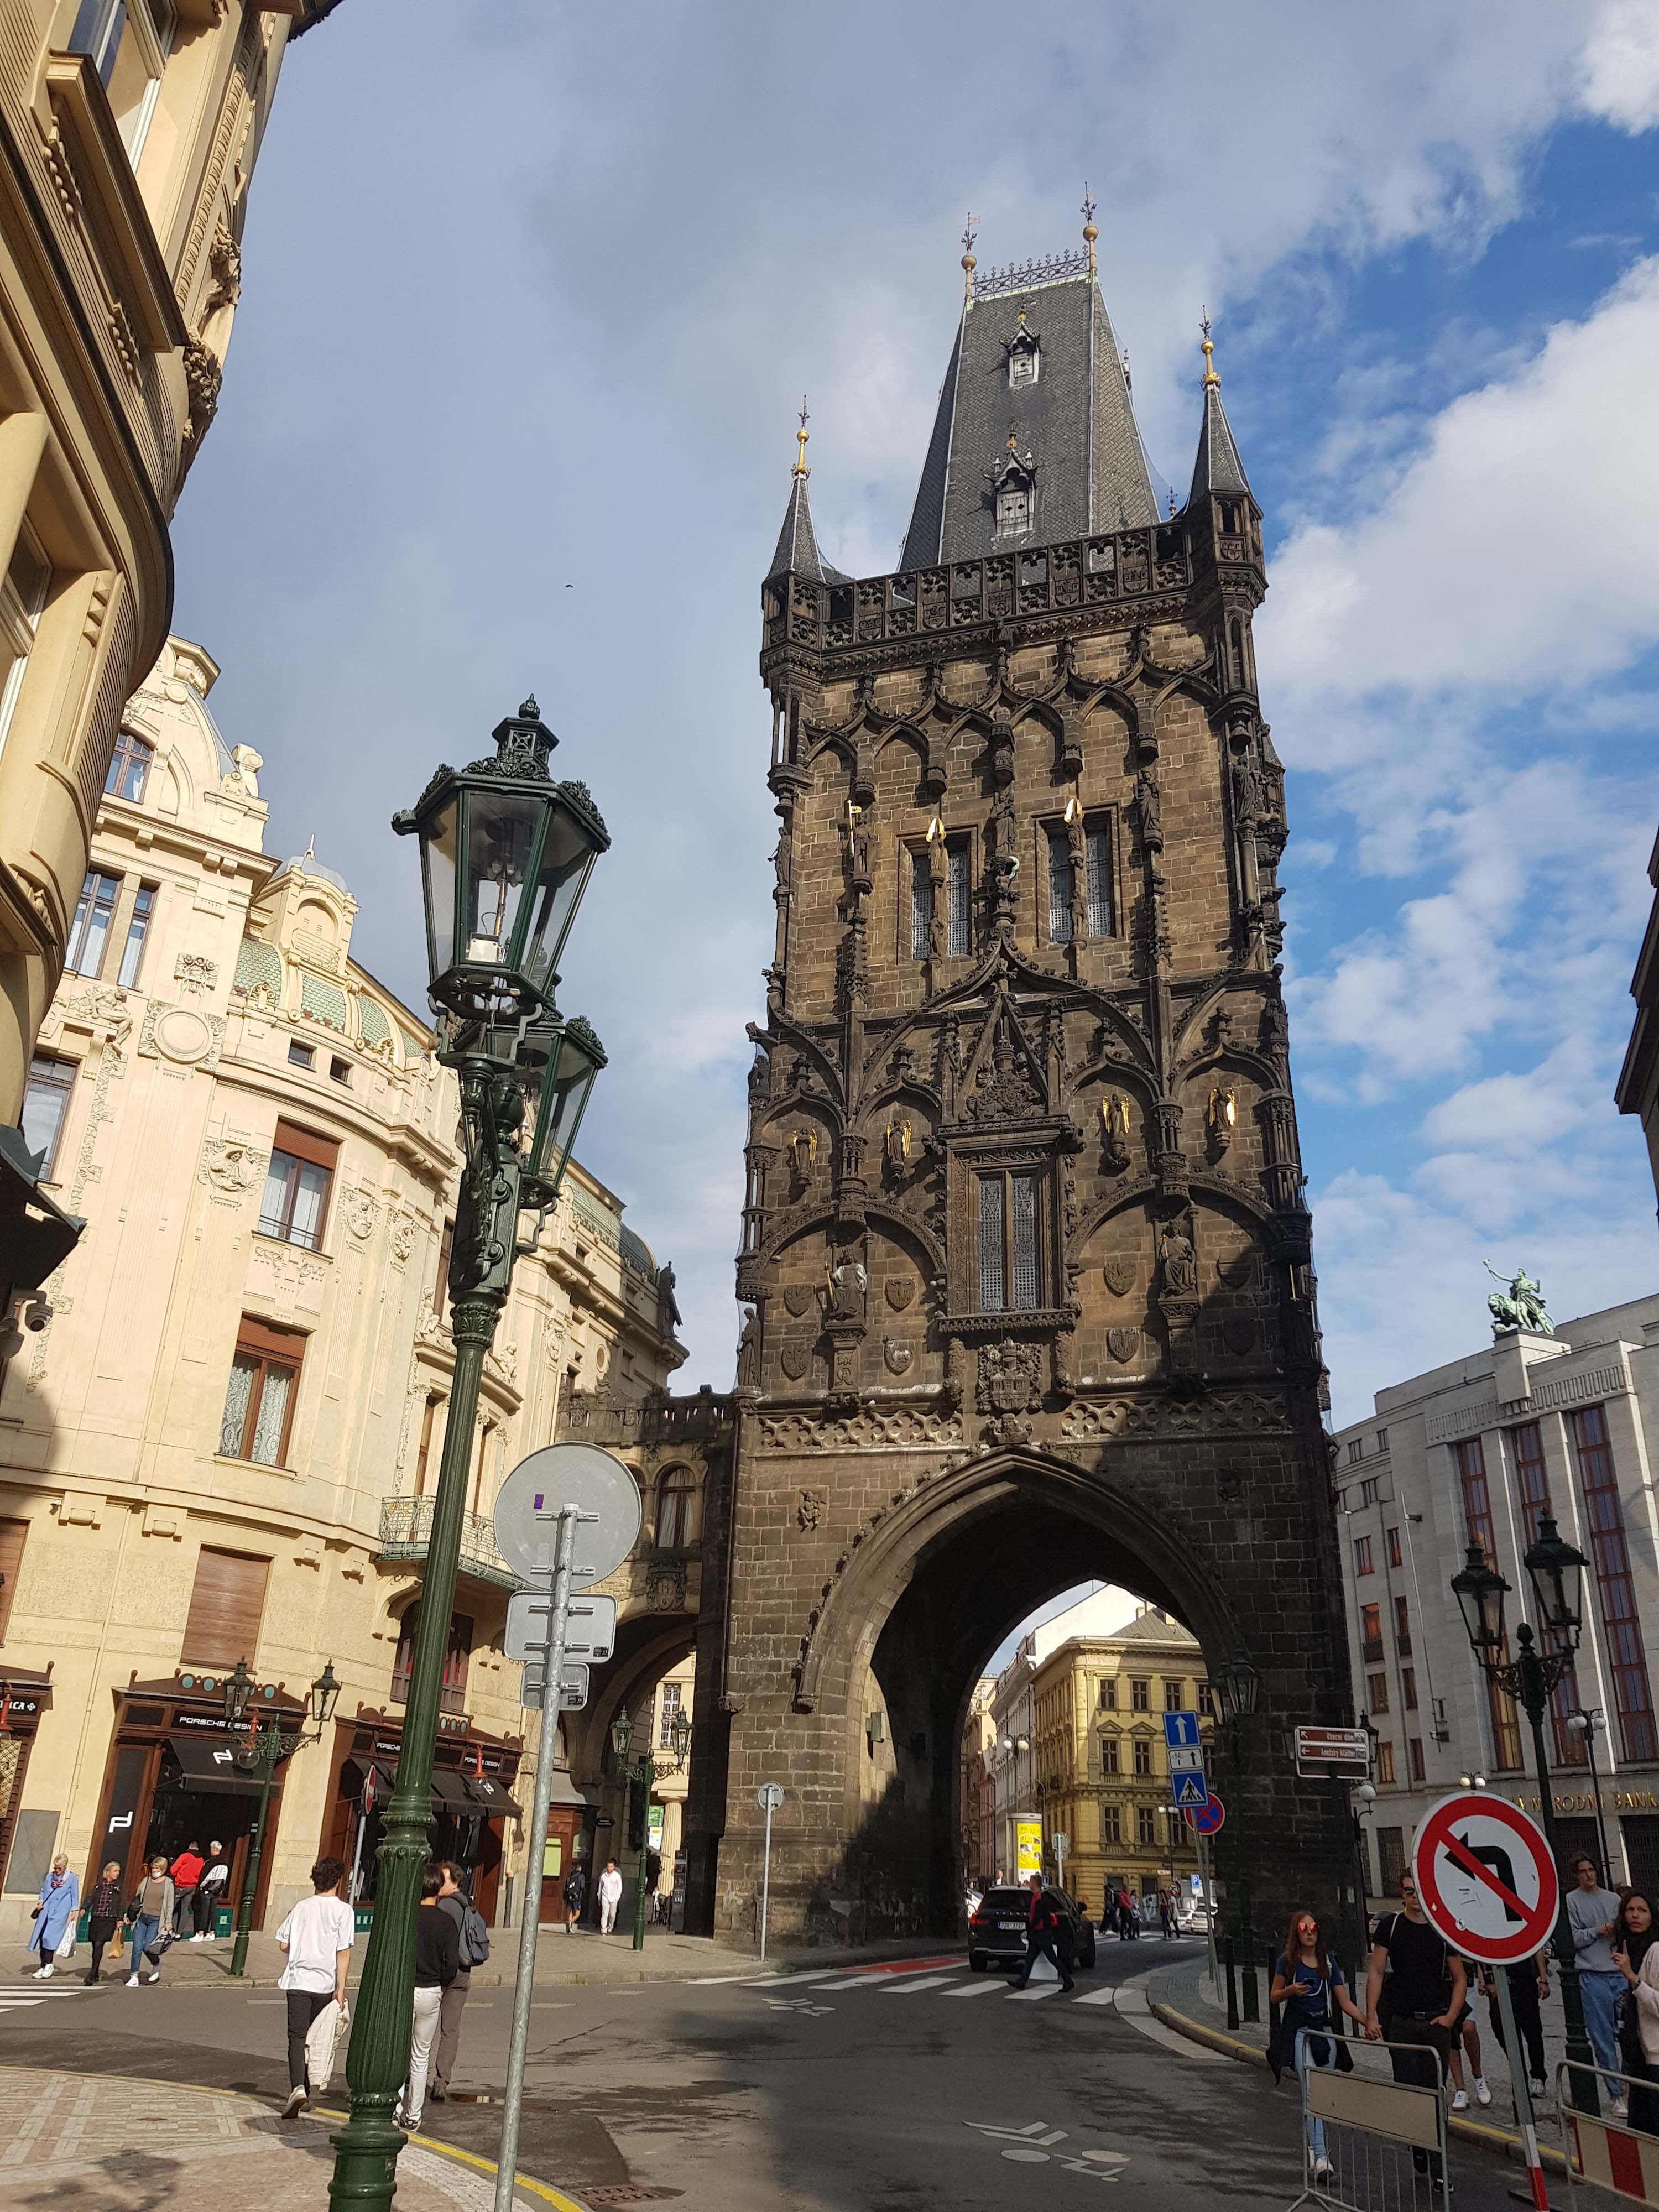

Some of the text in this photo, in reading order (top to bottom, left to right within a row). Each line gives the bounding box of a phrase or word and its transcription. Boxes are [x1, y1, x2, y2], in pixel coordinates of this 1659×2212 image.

[179, 1717, 263, 1731] PORSCHE ESIN
[377, 1743, 401, 1751] PORSCHE
[464, 1756, 484, 1765] PORSE
[1531, 1792, 1604, 1811] NRODNÍ
